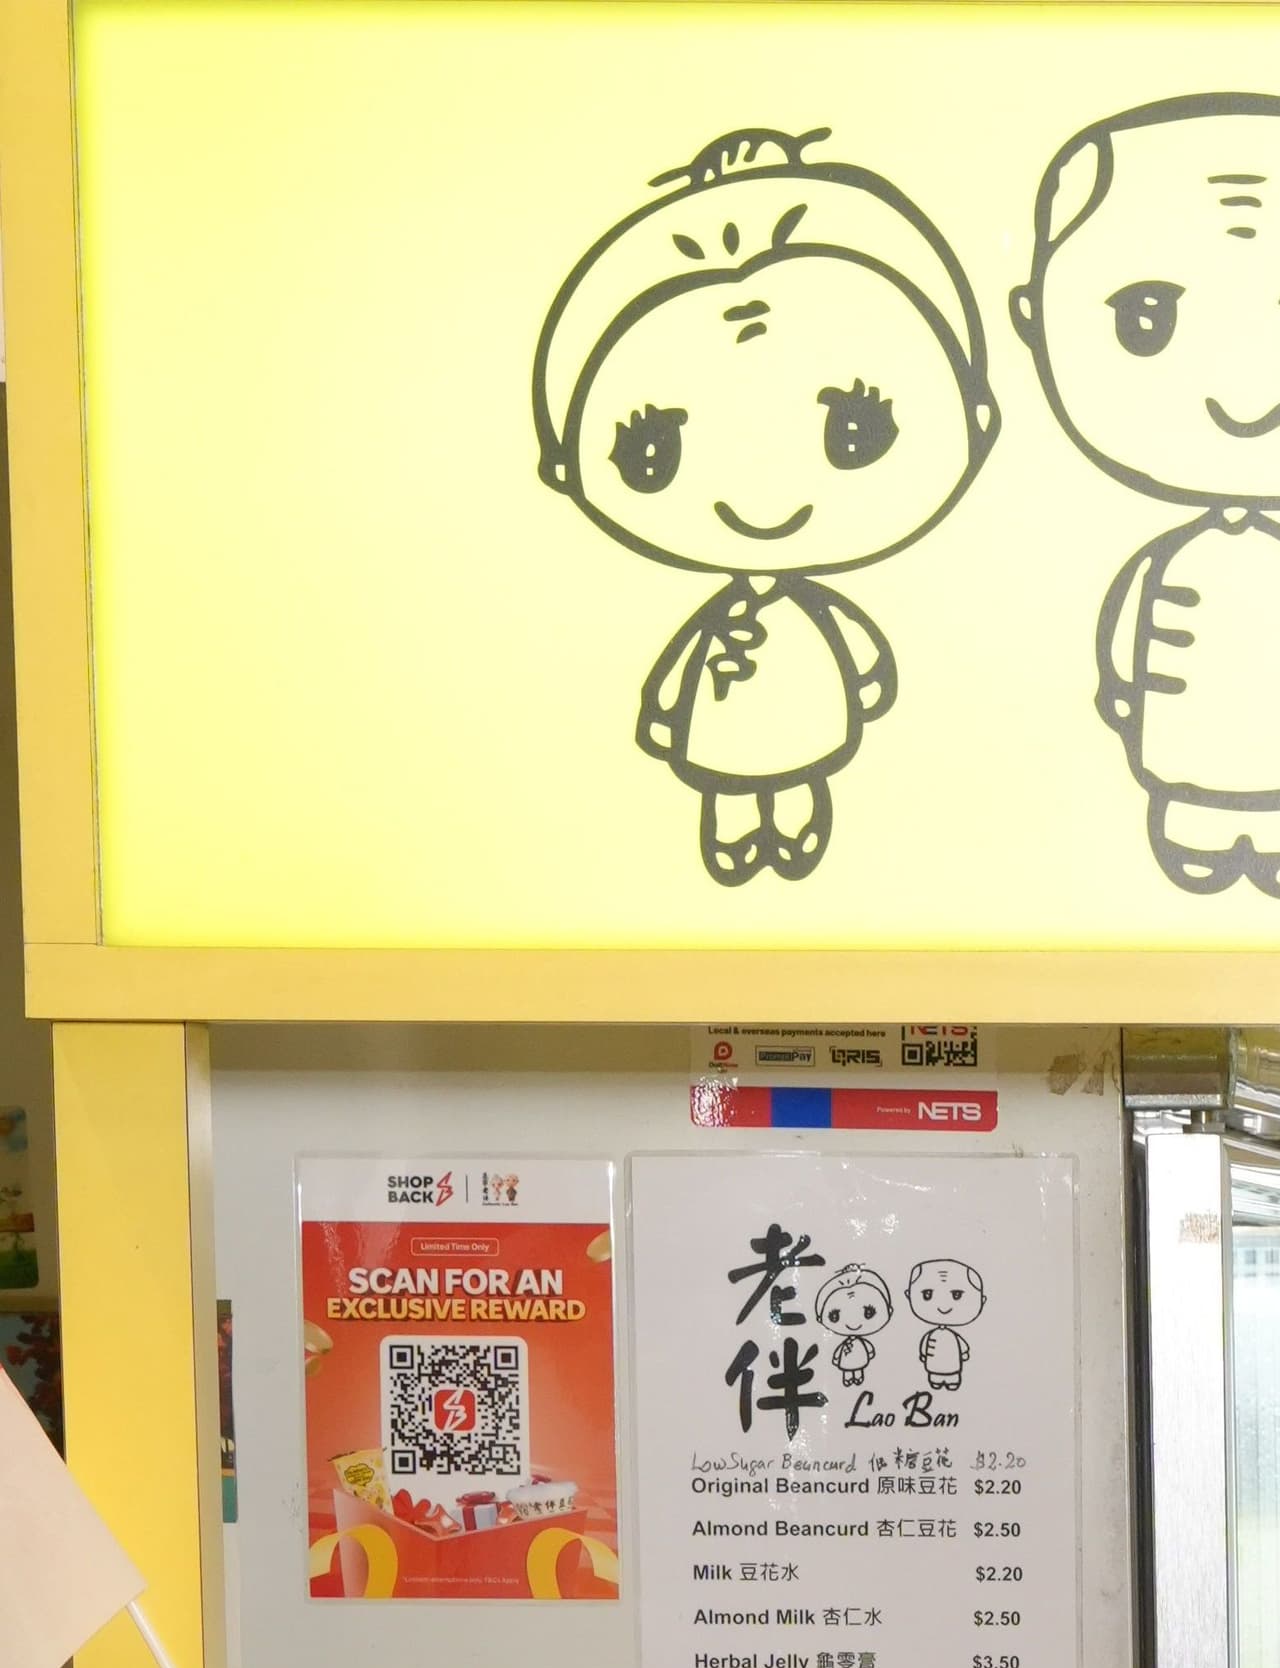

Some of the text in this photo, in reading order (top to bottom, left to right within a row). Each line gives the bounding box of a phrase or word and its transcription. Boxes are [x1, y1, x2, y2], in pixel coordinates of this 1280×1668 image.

[708, 1025, 886, 1038] Local overseas payments accepted here
[917, 1101, 982, 1121] NETS
[388, 1175, 434, 1189] SHOP
[388, 1190, 434, 1204] BACK
[420, 1241, 490, 1253] Limited Time Only
[348, 1267, 563, 1296] SCAN FOR AN
[327, 1298, 587, 1321] EXCLUSIVE REWARD
[724, 1223, 829, 1442] 老伴
[844, 1390, 960, 1429] Lao Ban
[691, 1476, 1022, 1497] Original Beancurd 原味豆花 $2.20
[692, 1518, 1021, 1539] Almond Beancurd 杏仁豆花 $2.50
[693, 1562, 1023, 1583] Milk 豆花水 $2.20
[693, 1607, 1021, 1627] Almond Milk 杏仁水 $2.50
